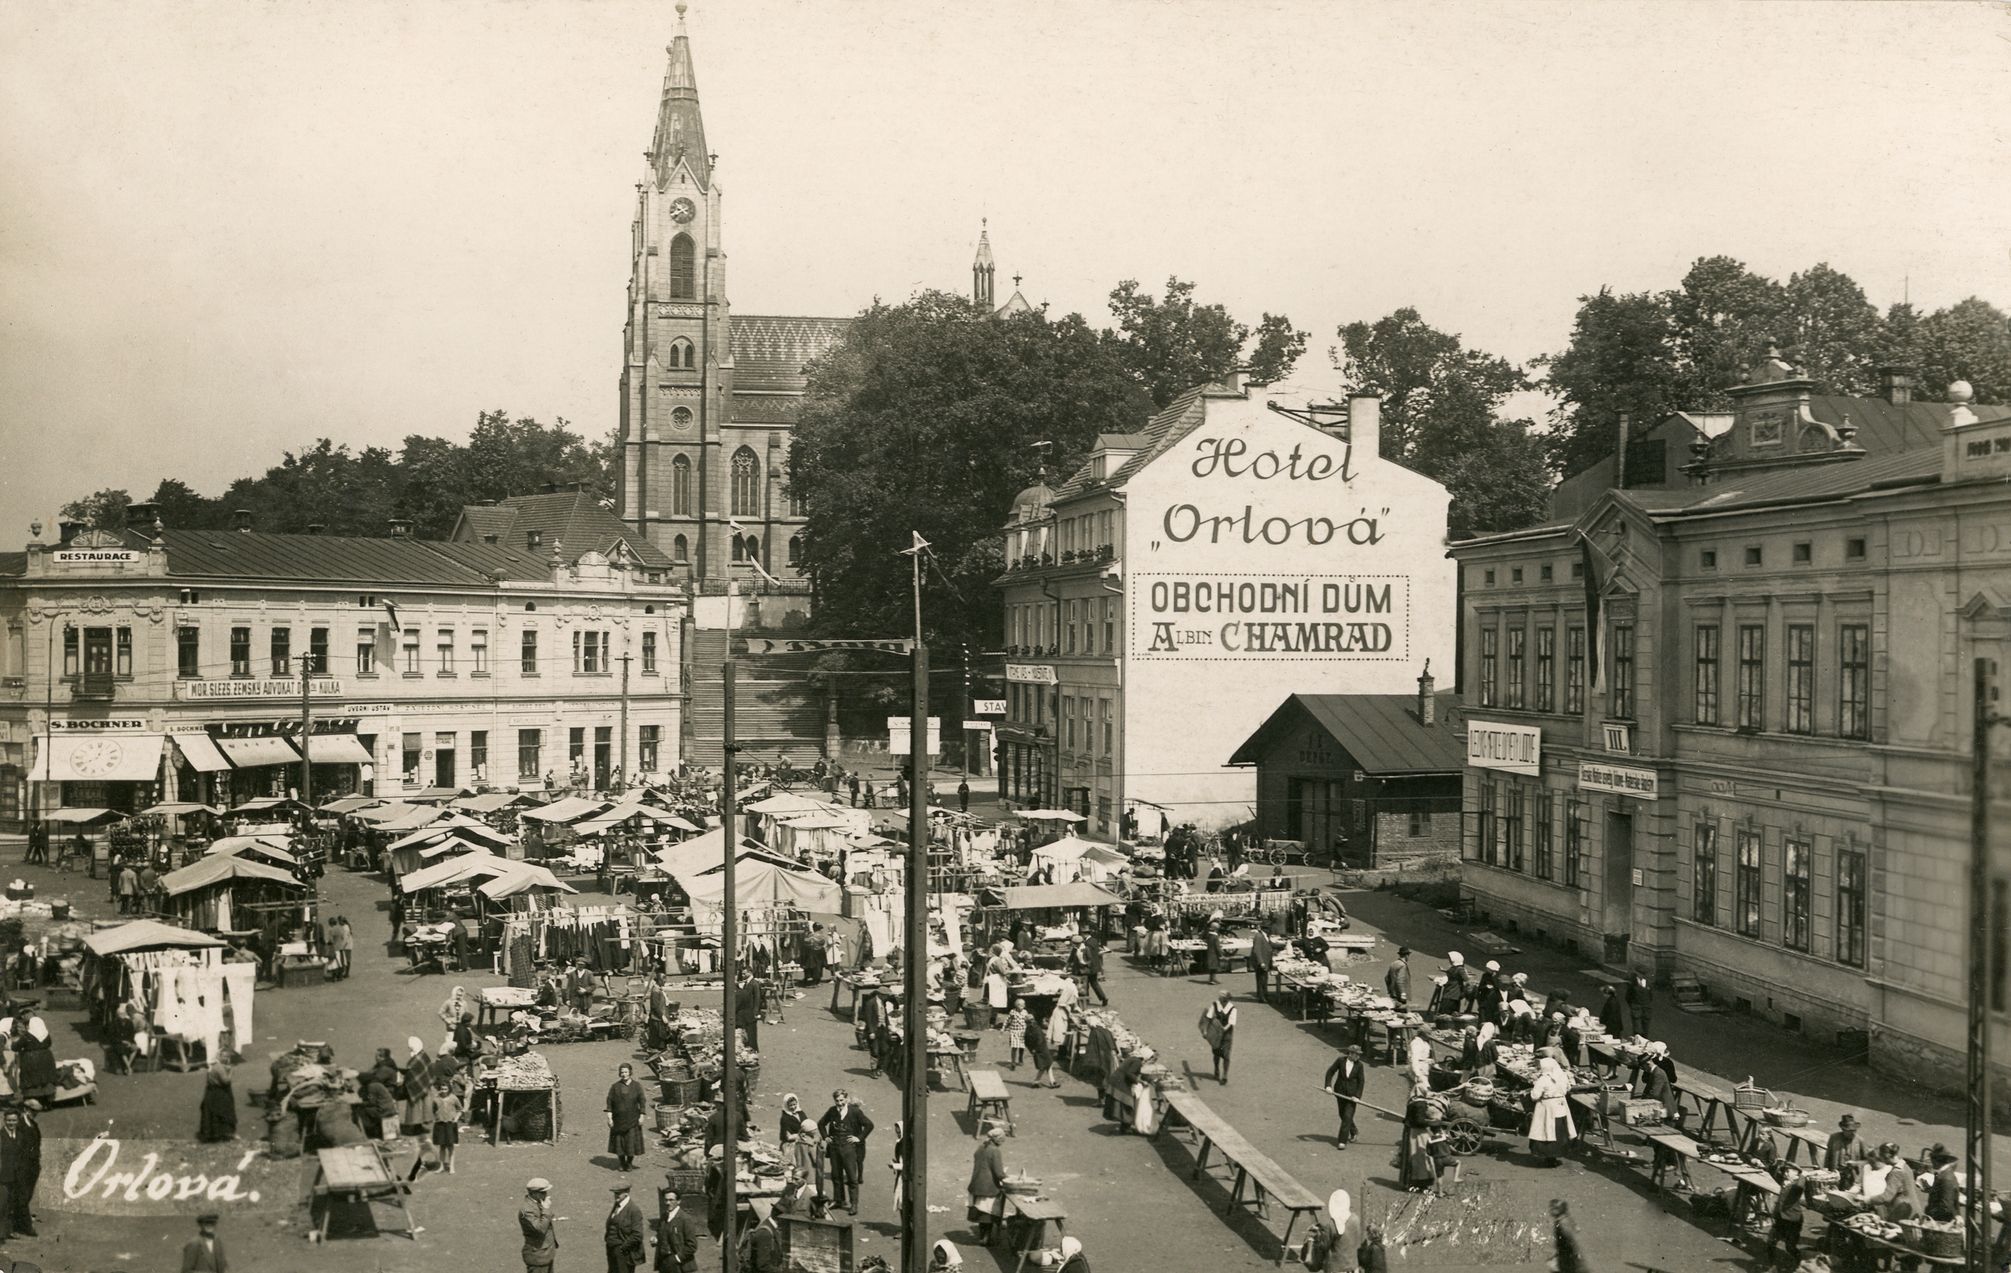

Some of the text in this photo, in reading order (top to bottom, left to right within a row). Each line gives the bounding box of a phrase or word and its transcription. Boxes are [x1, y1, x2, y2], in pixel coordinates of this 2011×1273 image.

[1191, 437, 1360, 483] Hotel
[60, 553, 132, 562] RESTAURACE
[1151, 577, 1392, 614] OBCHODNÍ DŮM
[1220, 620, 1393, 653] CHAMRAD
